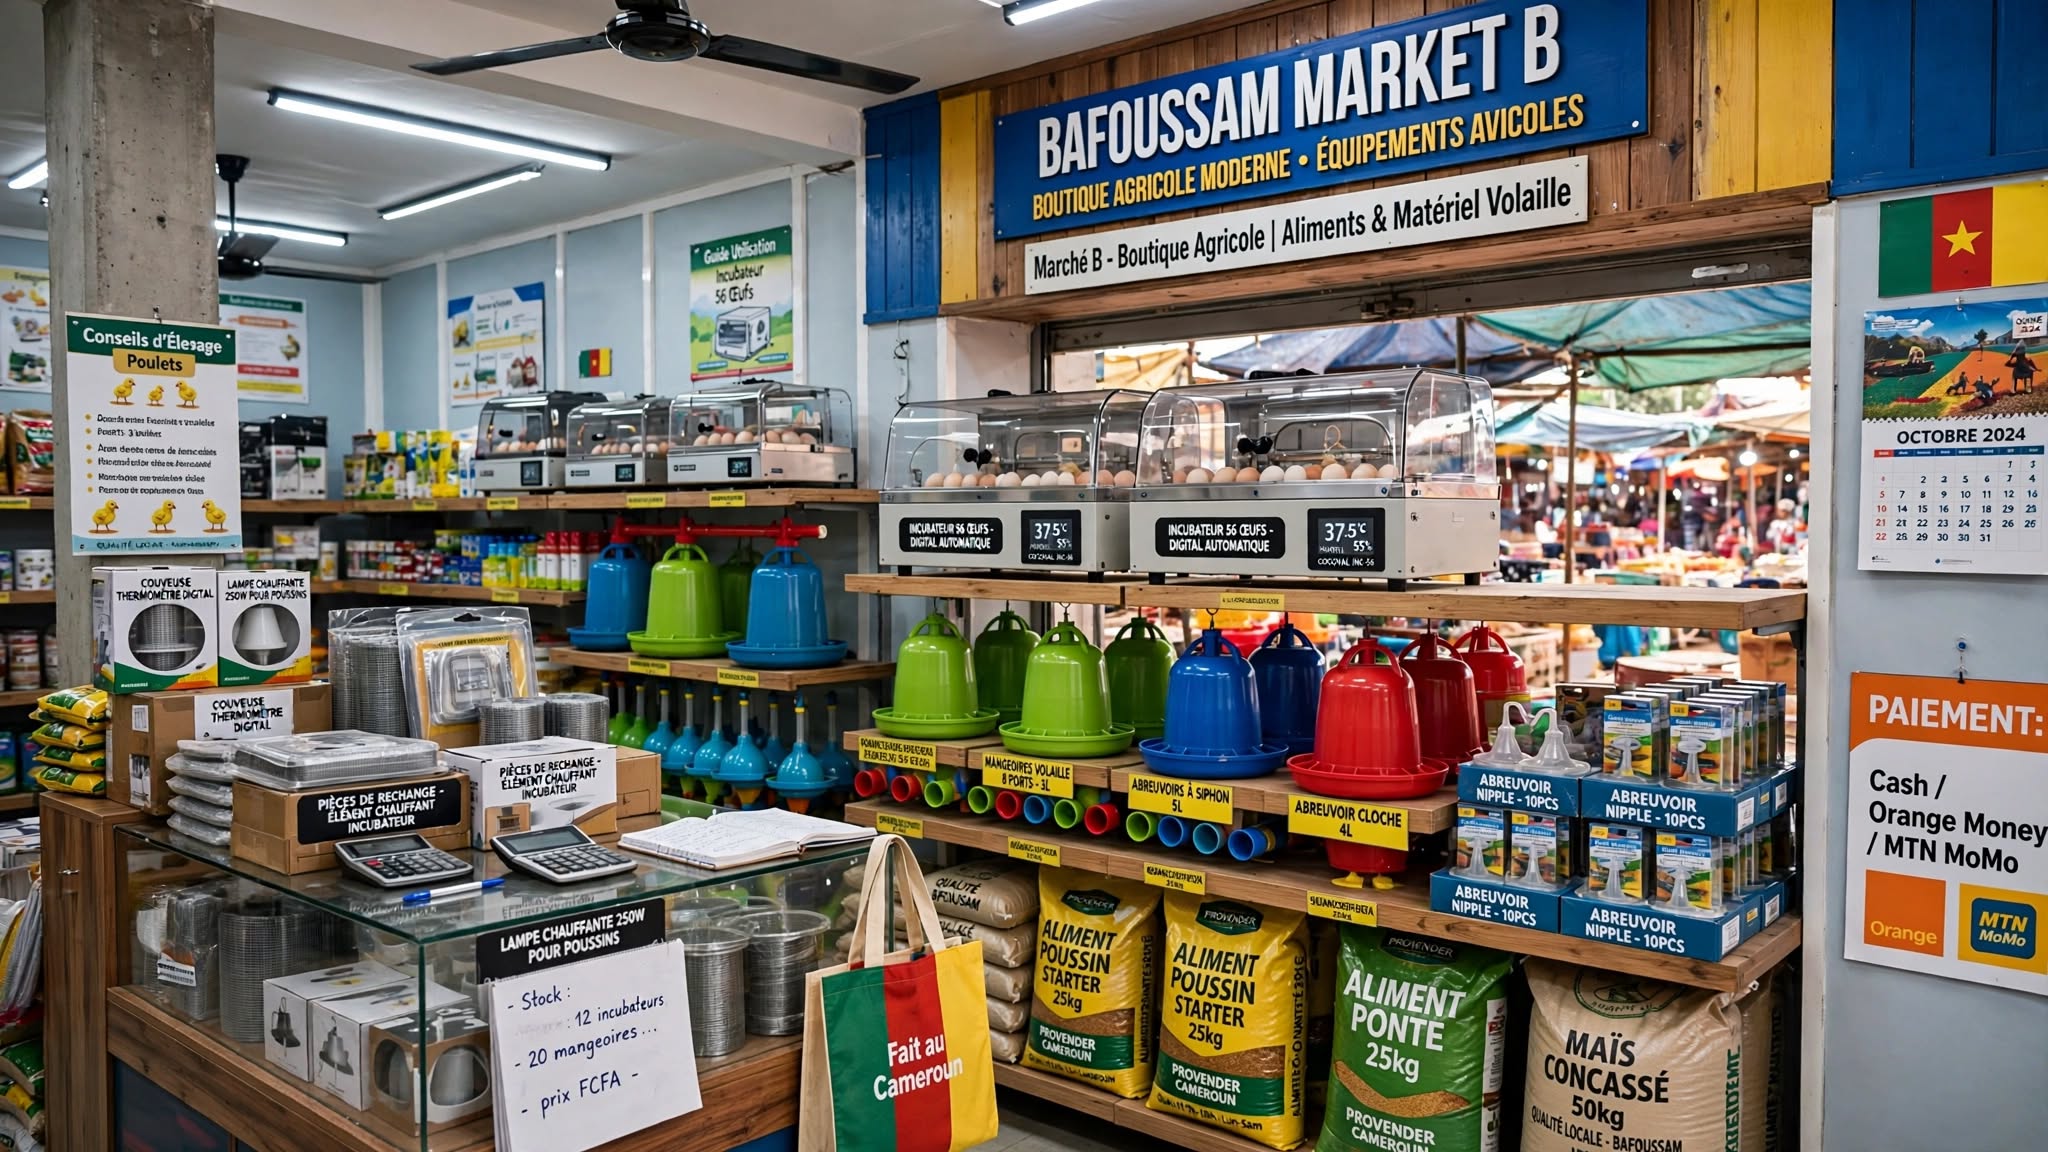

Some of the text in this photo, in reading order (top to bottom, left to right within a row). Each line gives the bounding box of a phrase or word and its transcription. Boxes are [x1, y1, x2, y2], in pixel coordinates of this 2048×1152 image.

[1039, 3, 1560, 179] BAFOUSSAM MARKET B
[1033, 93, 1585, 221] BOUTIQUE AGRICOLE MODERNE ÉQUIPEMENTS AVICOLES
[1034, 176, 1572, 280] Marché B Boutique Agricole Aliments & Matériel Volaille
[704, 238, 777, 264] Guide Utilisation
[716, 265, 764, 283] Incubateur
[715, 289, 726, 304] 56
[83, 327, 149, 348] Conseils
[127, 353, 183, 372] Poulets
[1897, 427, 2026, 444] OCTOBRE 2024
[1982, 490, 1991, 498] 11
[2004, 490, 2015, 498] 12
[1898, 505, 1908, 513] 14
[1939, 505, 1949, 513] 16
[1960, 505, 1970, 513] 17
[1982, 505, 1992, 513] 18
[909, 523, 954, 534] INCUBATEUR
[1168, 523, 1267, 537] INCUBATEUR 56 ŒUFS
[1917, 519, 1928, 527] 22
[1937, 519, 1949, 527] 23
[1980, 520, 1992, 528] 25
[2002, 519, 2014, 527] 26
[910, 537, 937, 547] DIGITAL
[1169, 539, 1269, 553] DIGITAL AUTOMATIQUE
[1937, 533, 1948, 541] 30
[141, 577, 191, 588] COUVEUSE
[183, 589, 214, 600] DIGITAL
[228, 579, 254, 589] LAMPE
[225, 591, 247, 600] 250W
[212, 697, 264, 710] COUVEUSE
[1869, 694, 2044, 737] PAIEMENT:
[234, 720, 271, 732] DIGITAL
[534, 763, 545, 773] DE
[549, 757, 594, 770] RECHANGE
[545, 768, 597, 784] CHAUFFANT
[1035, 763, 1070, 779] VOLAILLE
[522, 783, 577, 800] INCUBATEUR
[1008, 774, 1034, 788] PORTS
[1041, 779, 1050, 791] 3L
[1132, 778, 1184, 797] ABREUVOIRS
[1196, 787, 1229, 803] SIPHON
[1480, 774, 1552, 794] ABREUVOIR
[1870, 769, 1947, 800] Cash /
[318, 786, 436, 811] PIÈCES DE RECHANGE
[375, 799, 435, 816] CHAUFFANT
[1172, 799, 1183, 812] 5L
[1477, 788, 1559, 811] NIPPLE 10PCS
[1611, 789, 1697, 812] ABREUVOIR
[348, 815, 415, 834] INCUBATEUR
[1295, 800, 1401, 827] ABREUVOIR CLOCHE
[1606, 804, 1705, 830] NIPPLE 10PCS
[1869, 800, 2048, 848] Orange Money
[1339, 823, 1352, 838] 4L
[1867, 832, 2019, 874] / MTN MoMo
[1455, 884, 1529, 909] ABREUVOIR
[1452, 900, 1536, 926] NIPPLE 10PCS
[1590, 908, 1676, 935] ABREUVOIR
[1979, 911, 2028, 933] MTN
[500, 907, 646, 952] LAMPE CHAUFFANTE 250W
[1042, 919, 1117, 950] ALIMENT
[1585, 923, 1685, 953] NIPPLE 10PCS
[1870, 920, 1937, 946] Orange
[1979, 928, 2026, 947] MoMo
[528, 931, 620, 964] POUR POUSSINS
[1039, 942, 1111, 974] POUSSIN
[1173, 942, 1260, 977] ALIMENT
[1042, 965, 1101, 993] STARTER
[1170, 967, 1255, 1005] POUSSIN
[521, 986, 562, 1011] Stock
[1053, 990, 1082, 1013] 25kg
[1343, 969, 1467, 1018] ALIMENT
[574, 994, 665, 1027] 12 incubateurs
[1174, 995, 1245, 1028] STARTER
[1039, 1025, 1096, 1050] PROVENDER
[1188, 1022, 1223, 1050] 25kg
[1351, 1003, 1445, 1052] PONTE
[529, 1048, 548, 1069] 20
[887, 1034, 945, 1068] Fait au
[1042, 1042, 1092, 1062] CAMEROUN
[1565, 1029, 1636, 1068] MAÏS
[1365, 1042, 1420, 1084] 25kg
[873, 1057, 964, 1101] Cameroun
[1172, 1063, 1241, 1093] PROVENDER
[1544, 1054, 1670, 1104] CONCASSÉ
[541, 1070, 621, 1119] prix FCFA
[1175, 1080, 1237, 1107] CAMEROUN
[1571, 1095, 1624, 1131] 50kg
[1346, 1107, 1436, 1146] PROVENDER
[1351, 1126, 1429, 1152] CAMEROUN
[1531, 1105, 1683, 1152] QUALITÉ LOCALE BAFOUSSAM
